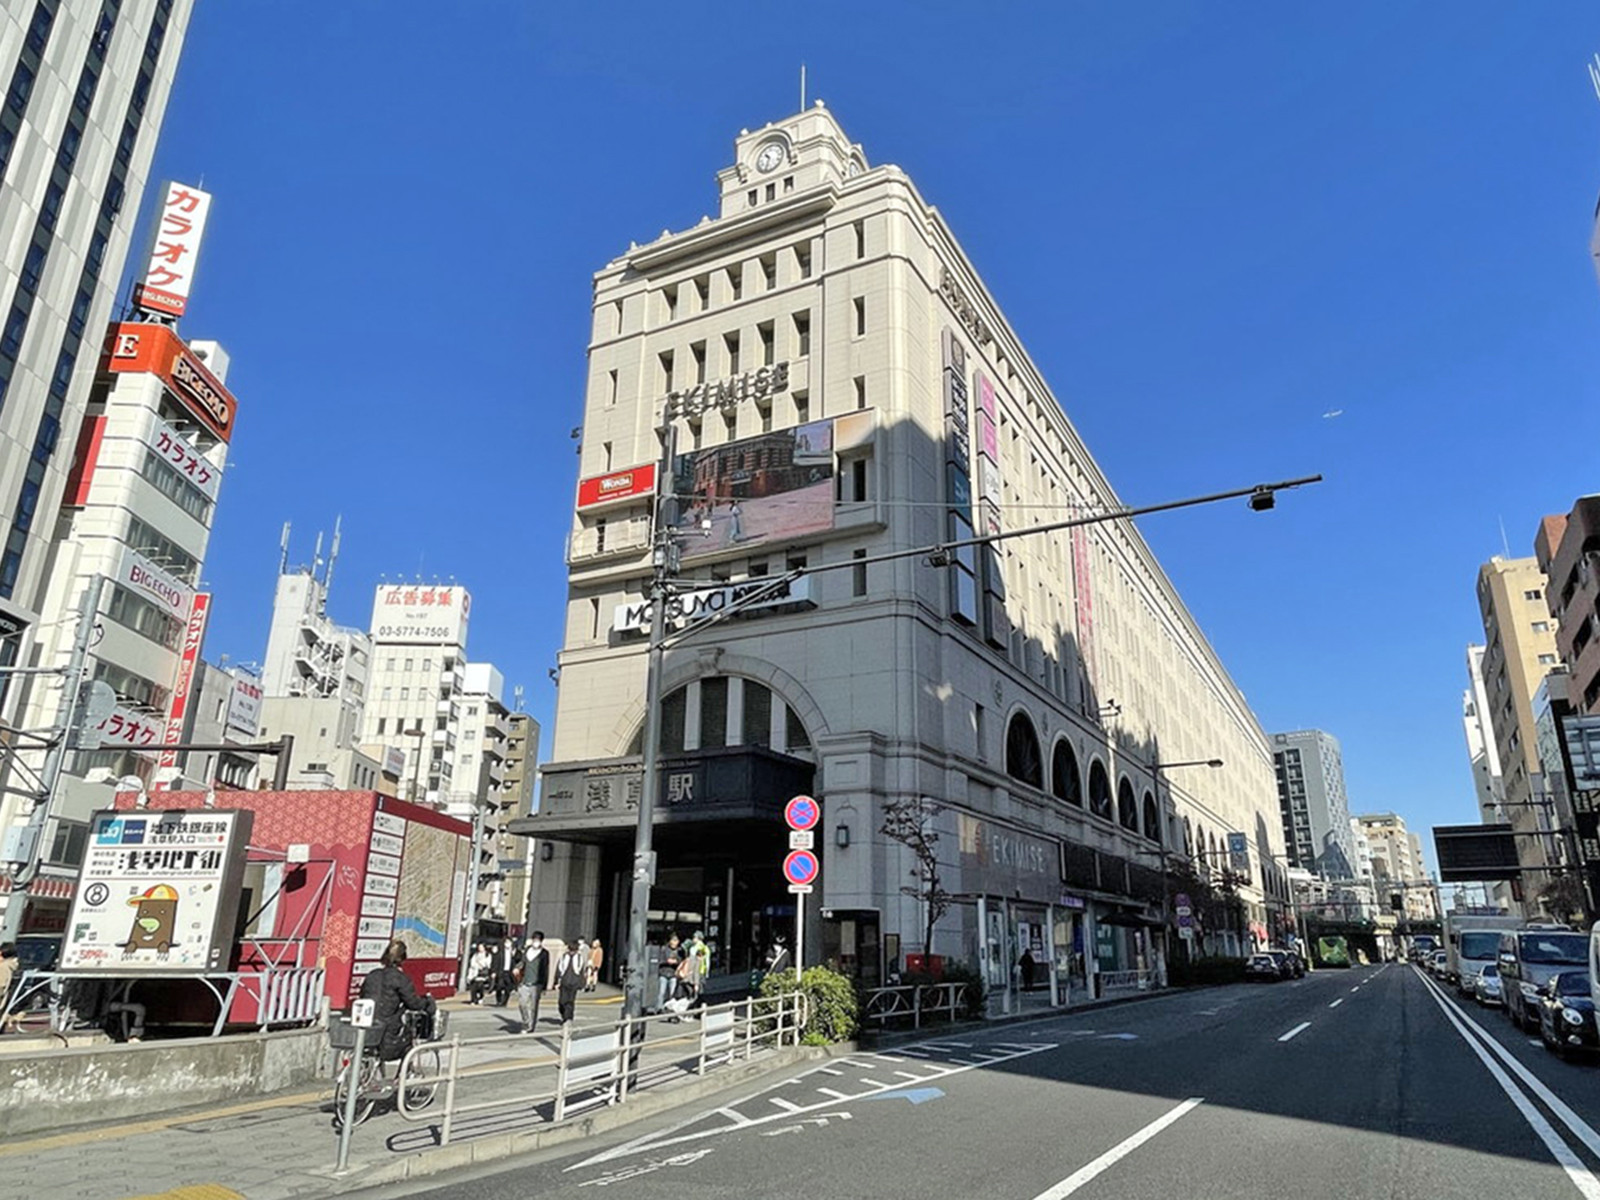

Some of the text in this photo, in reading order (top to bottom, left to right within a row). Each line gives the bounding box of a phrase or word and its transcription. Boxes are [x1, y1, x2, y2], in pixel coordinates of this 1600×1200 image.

[147, 189, 200, 287] カラオケ
[666, 361, 789, 420] EKIMISE
[156, 431, 212, 485] カラオケ
[384, 590, 453, 607] 広告募集
[184, 608, 204, 651] カラオケ
[378, 625, 450, 638] 03-5774-7506
[97, 713, 156, 746] ラオケ
[160, 718, 181, 763] カラケ
[992, 834, 1045, 874] EKIMISE
